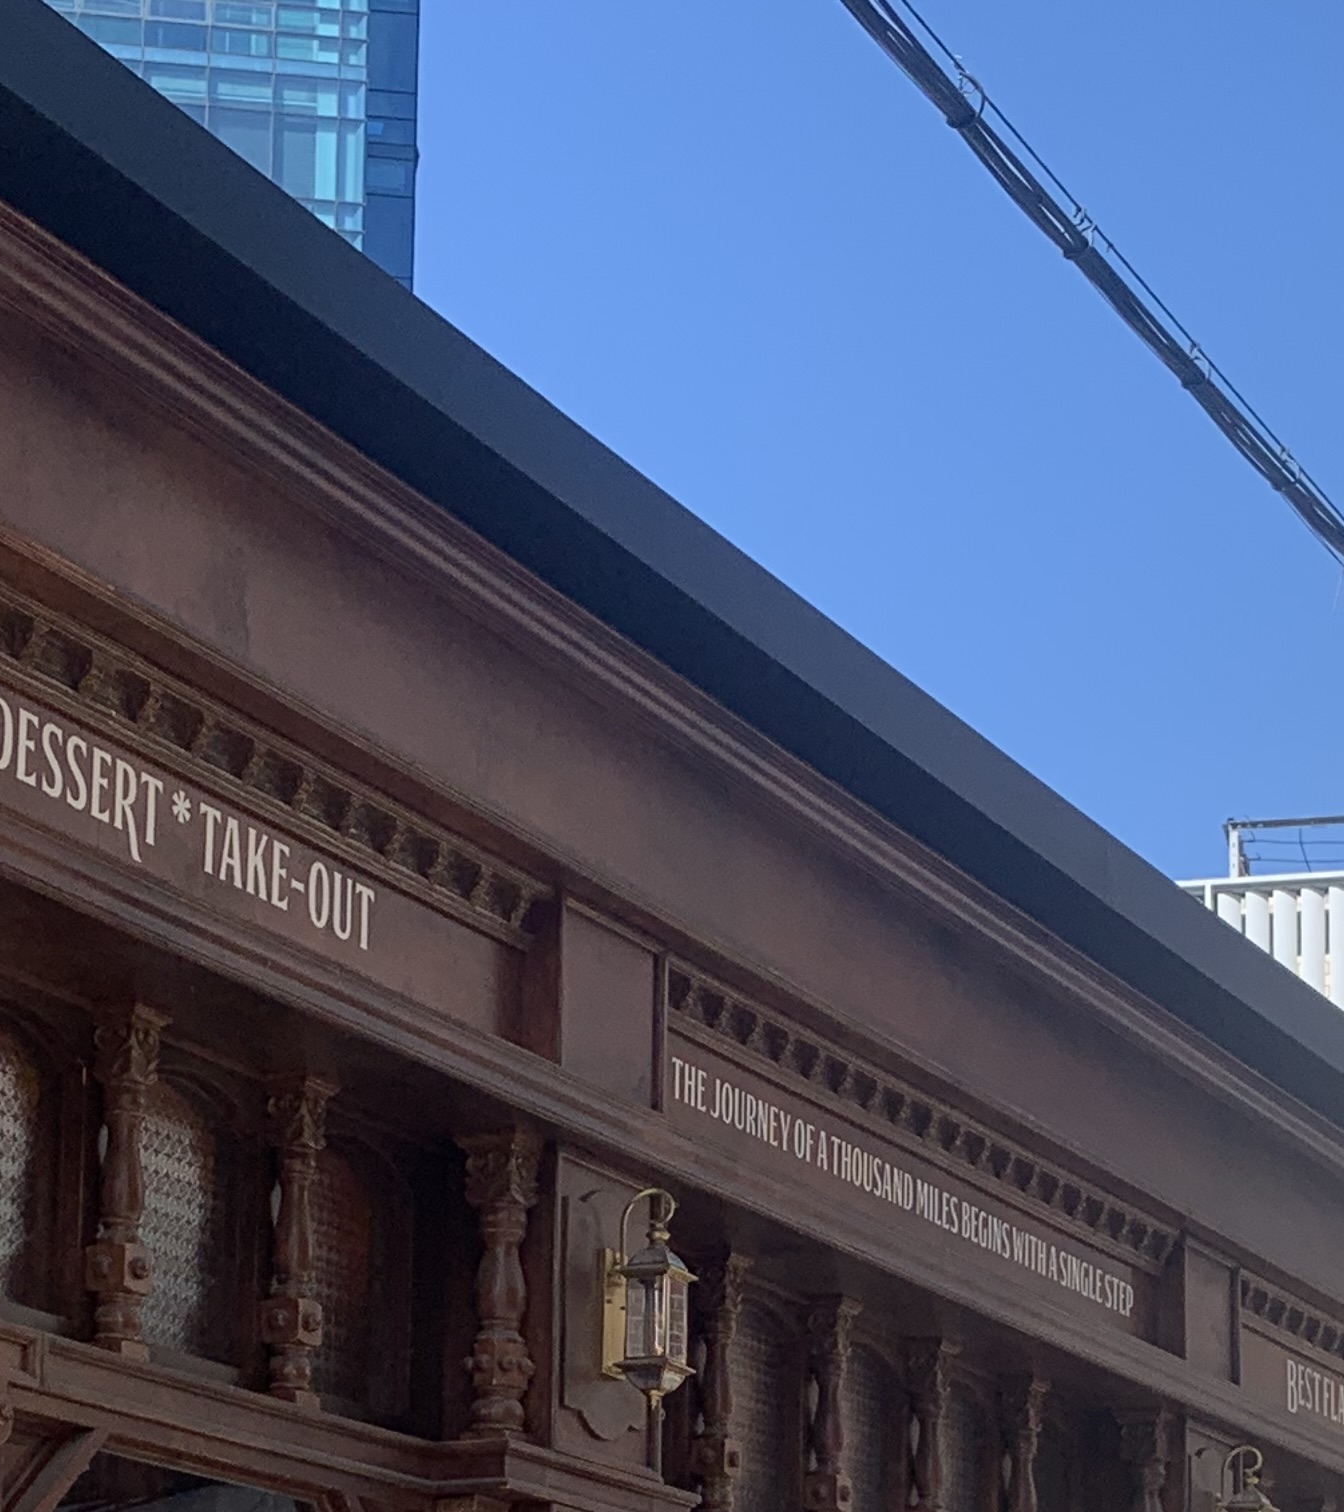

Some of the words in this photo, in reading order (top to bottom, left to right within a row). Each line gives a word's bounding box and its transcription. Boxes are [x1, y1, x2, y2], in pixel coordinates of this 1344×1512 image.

[199, 802, 376, 950] TAKE-OUT
[671, 1056, 707, 1113] THE
[710, 1078, 791, 1151] JOURNEY
[794, 1118, 816, 1163] OF
[817, 1130, 828, 1171] A
[830, 1135, 914, 1210] THOUSAND
[916, 1178, 959, 1234] MILES
[961, 1201, 1010, 1259] BEGINS
[1012, 1226, 1047, 1276] WITH
[1047, 1245, 1058, 1281] A
[1059, 1250, 1103, 1303] SINGLE
[1104, 1274, 1134, 1317] STEP
[1287, 1359, 1321, 1414] BEST
